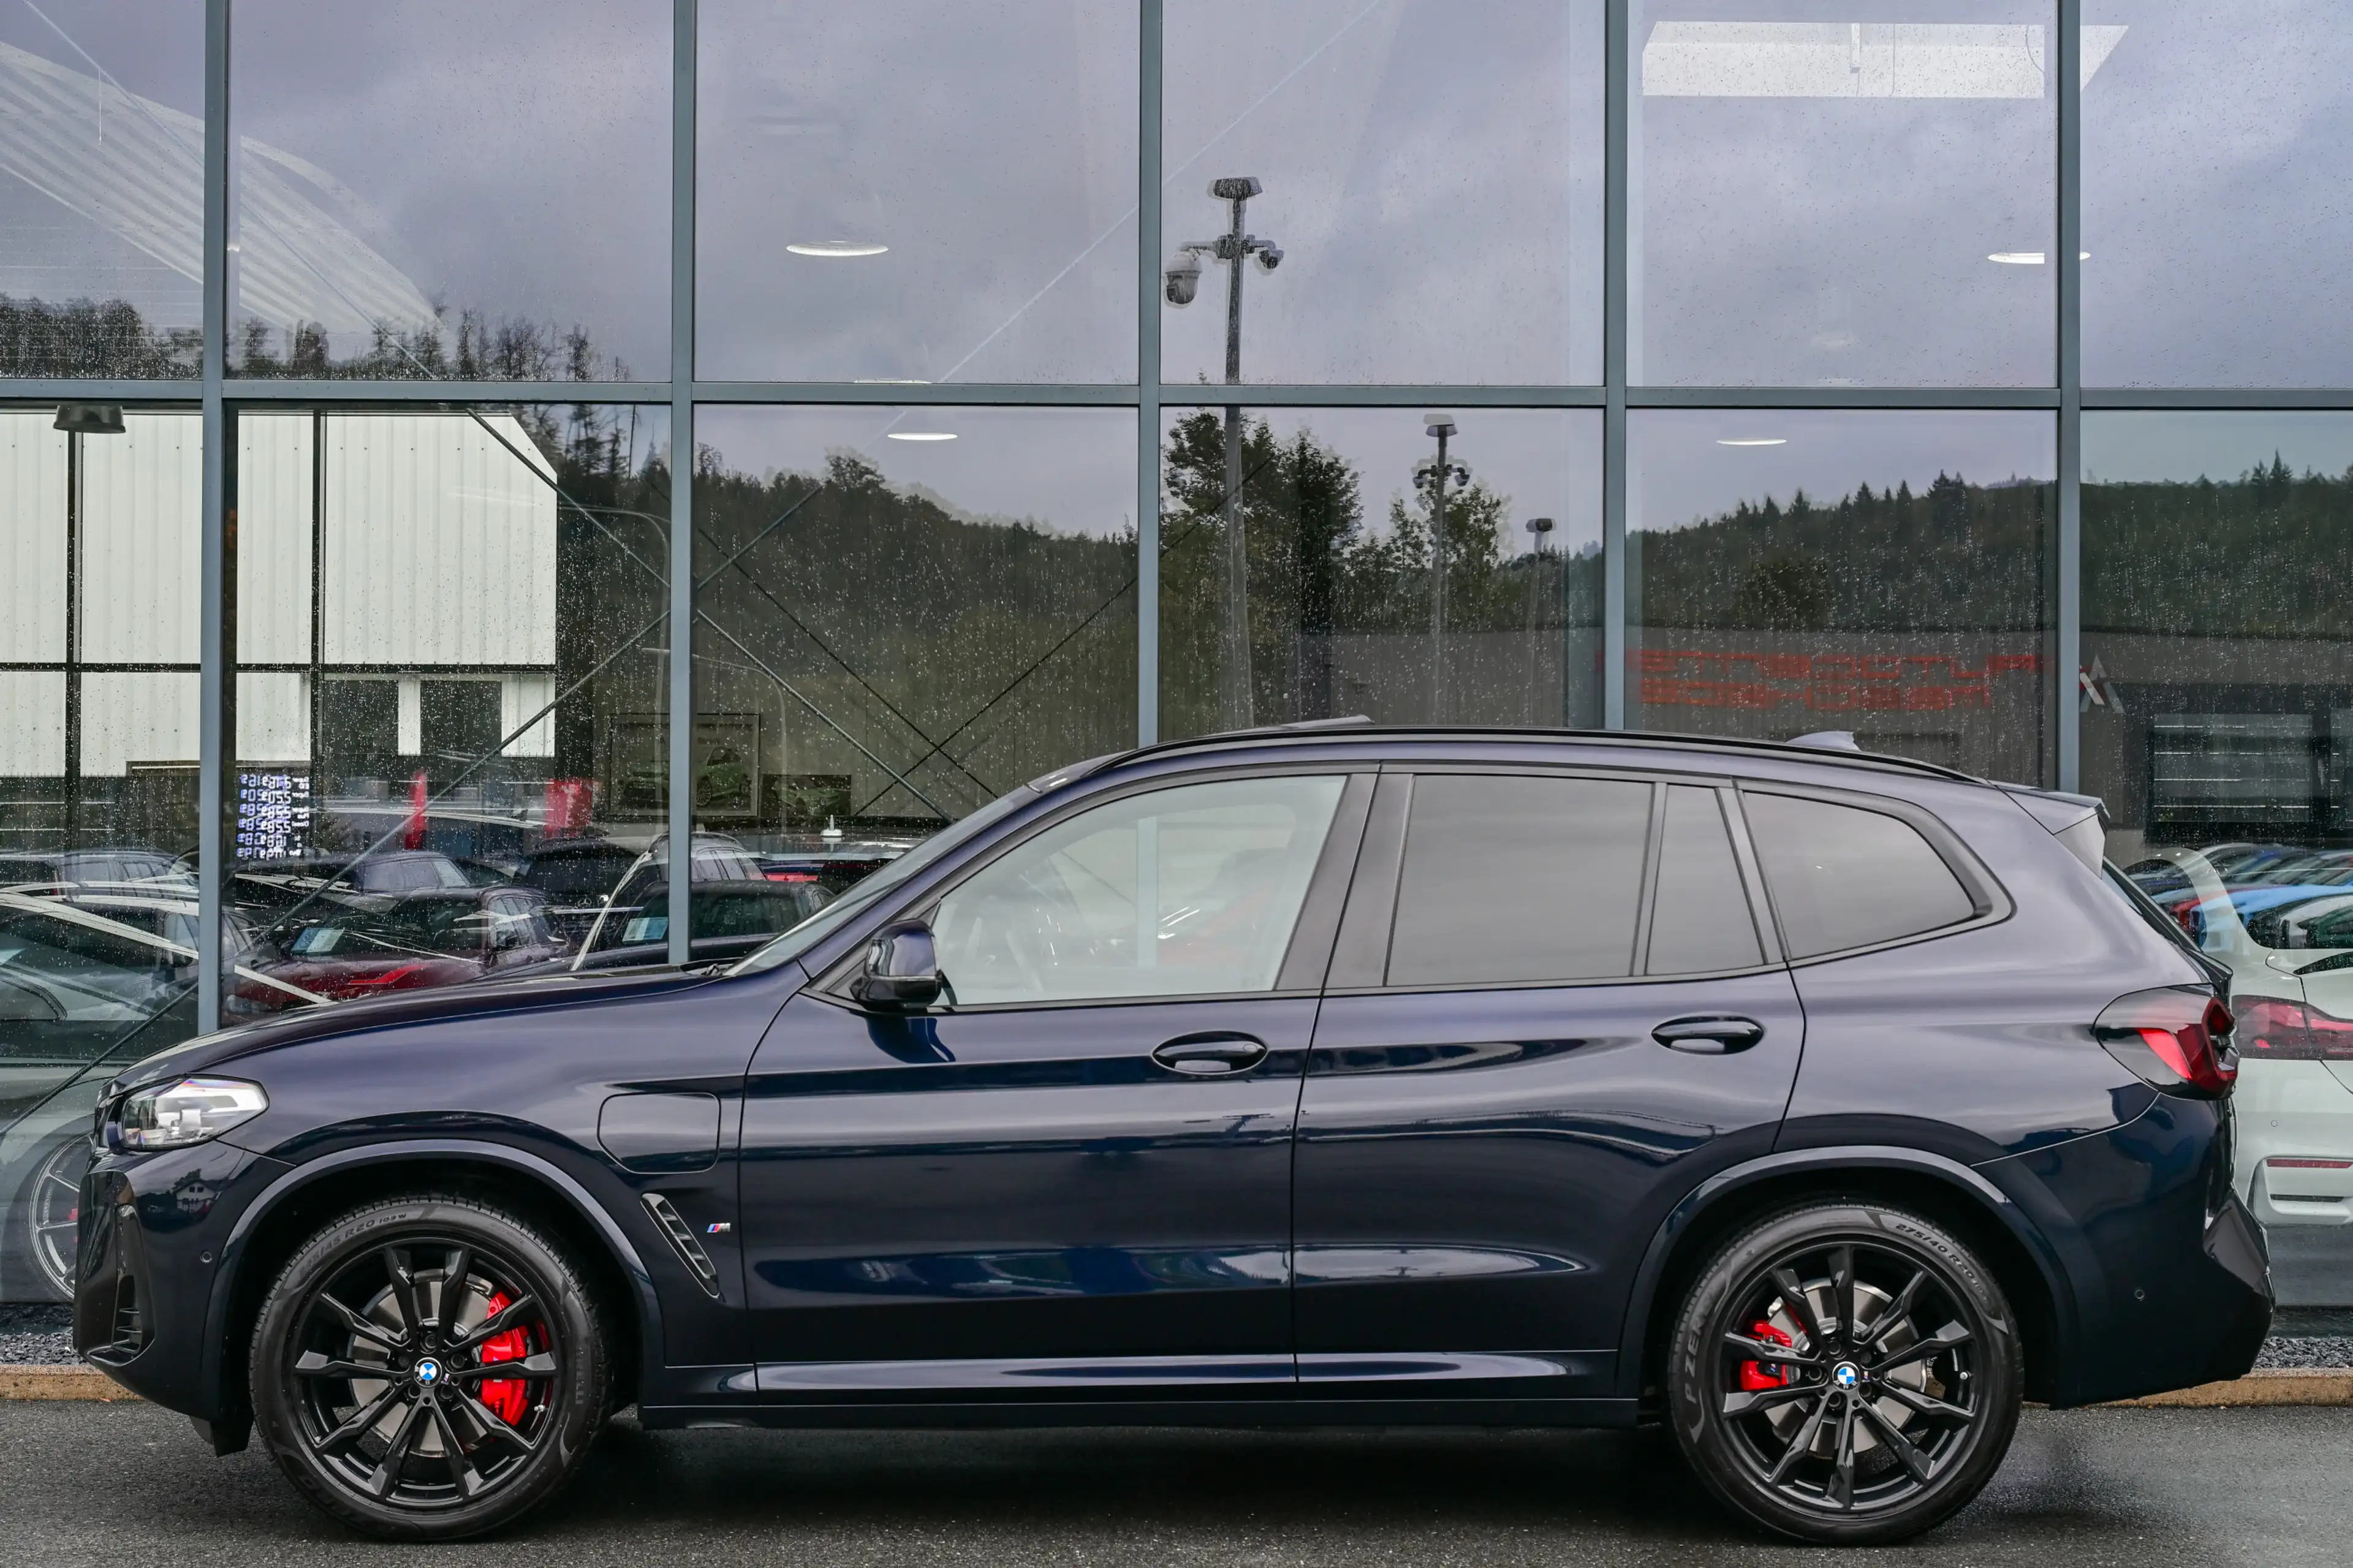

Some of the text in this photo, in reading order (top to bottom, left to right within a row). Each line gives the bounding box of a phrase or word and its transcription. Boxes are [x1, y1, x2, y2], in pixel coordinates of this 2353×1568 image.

[345, 1219, 376, 1238] R20
[1896, 1223, 1973, 1279] 275/40 R20
[575, 1351, 585, 1405] RELLI
[1684, 1383, 1697, 1404] P
